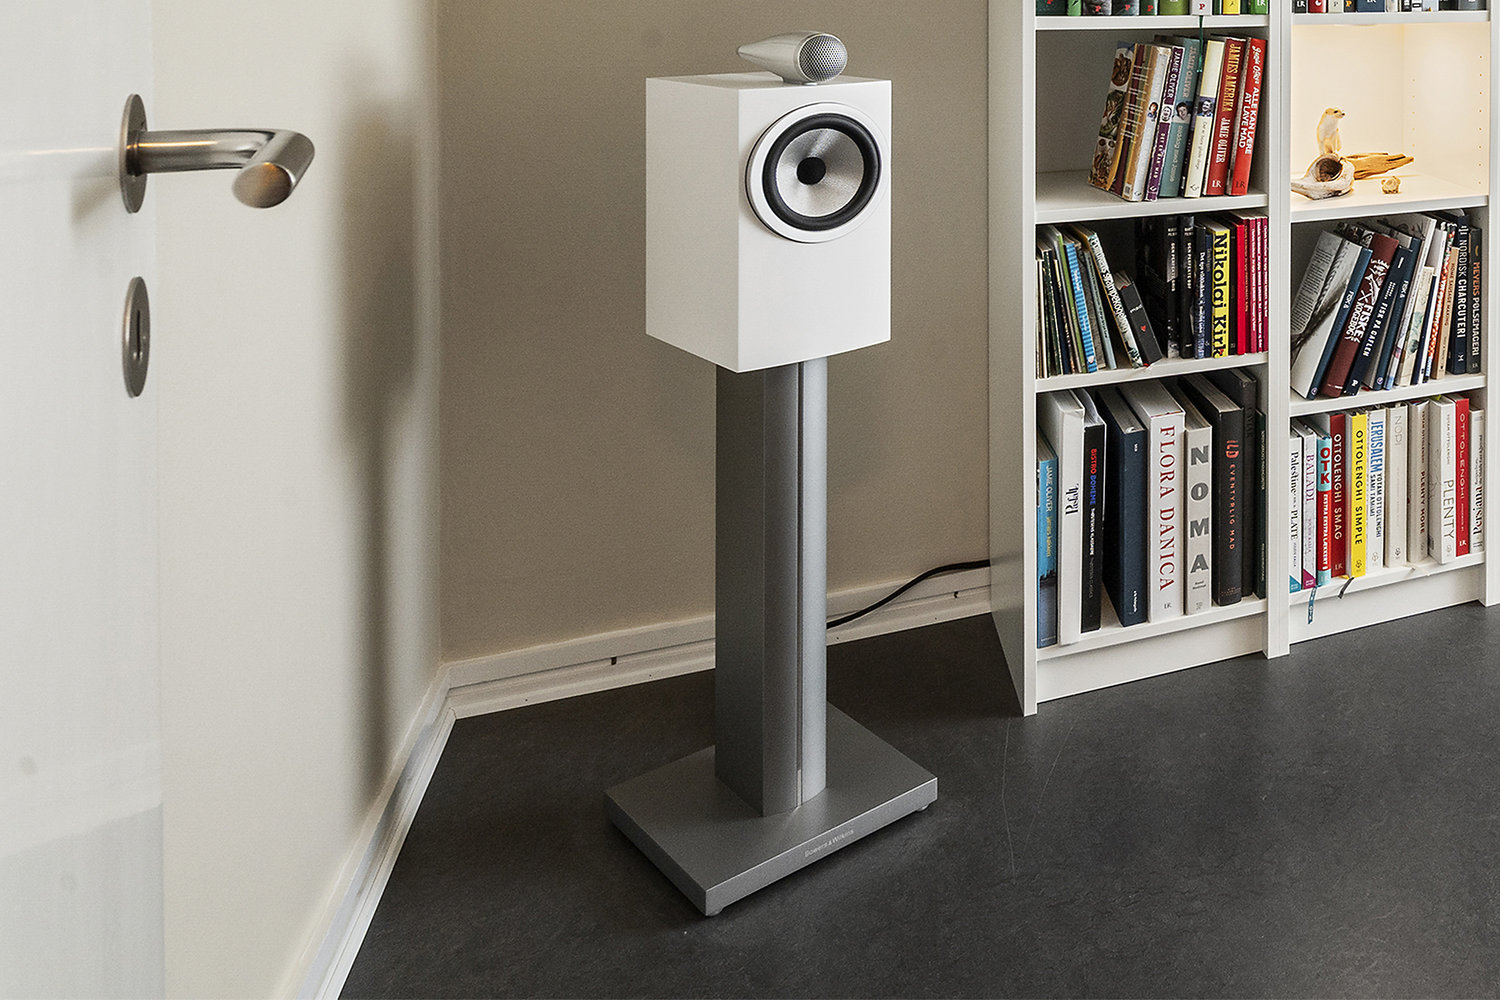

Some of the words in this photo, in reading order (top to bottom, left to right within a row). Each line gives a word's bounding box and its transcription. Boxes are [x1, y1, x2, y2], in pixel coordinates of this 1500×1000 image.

[1226, 44, 1241, 73] JAMIES
[1222, 75, 1238, 112] AMERIKA
[1251, 87, 1259, 109] ALLE
[1219, 117, 1231, 138] JAMIE
[1241, 107, 1250, 126] LAVE
[1248, 111, 1257, 129] KAN
[1216, 140, 1228, 163] OLIVER
[1239, 127, 1247, 148] MAD
[1245, 131, 1254, 154] LÆRE
[1213, 233, 1227, 309] Nikolaj
[1458, 240, 1467, 277] NORDISK
[1472, 262, 1480, 296] MEYERS
[1355, 304, 1374, 338] FISKE
[1377, 302, 1388, 319] FISK
[1457, 279, 1467, 338] CHARCUTERI
[1213, 315, 1227, 357] Kirk
[1362, 331, 1378, 357] GAFLEN
[1159, 425, 1175, 499] FLORA
[1225, 440, 1239, 458] ILD
[1355, 430, 1363, 501] OTTOLENGHI
[1370, 421, 1383, 473] JERUSALEM
[1290, 452, 1299, 494] Palestine
[1306, 454, 1315, 502] BALADI
[1334, 434, 1342, 503] OTTOLENGHI
[1190, 445, 1209, 574] NOMA
[1355, 507, 1363, 545] SIMPLE
[1443, 480, 1454, 539] PLENTY
[1159, 506, 1175, 591] DANICA
